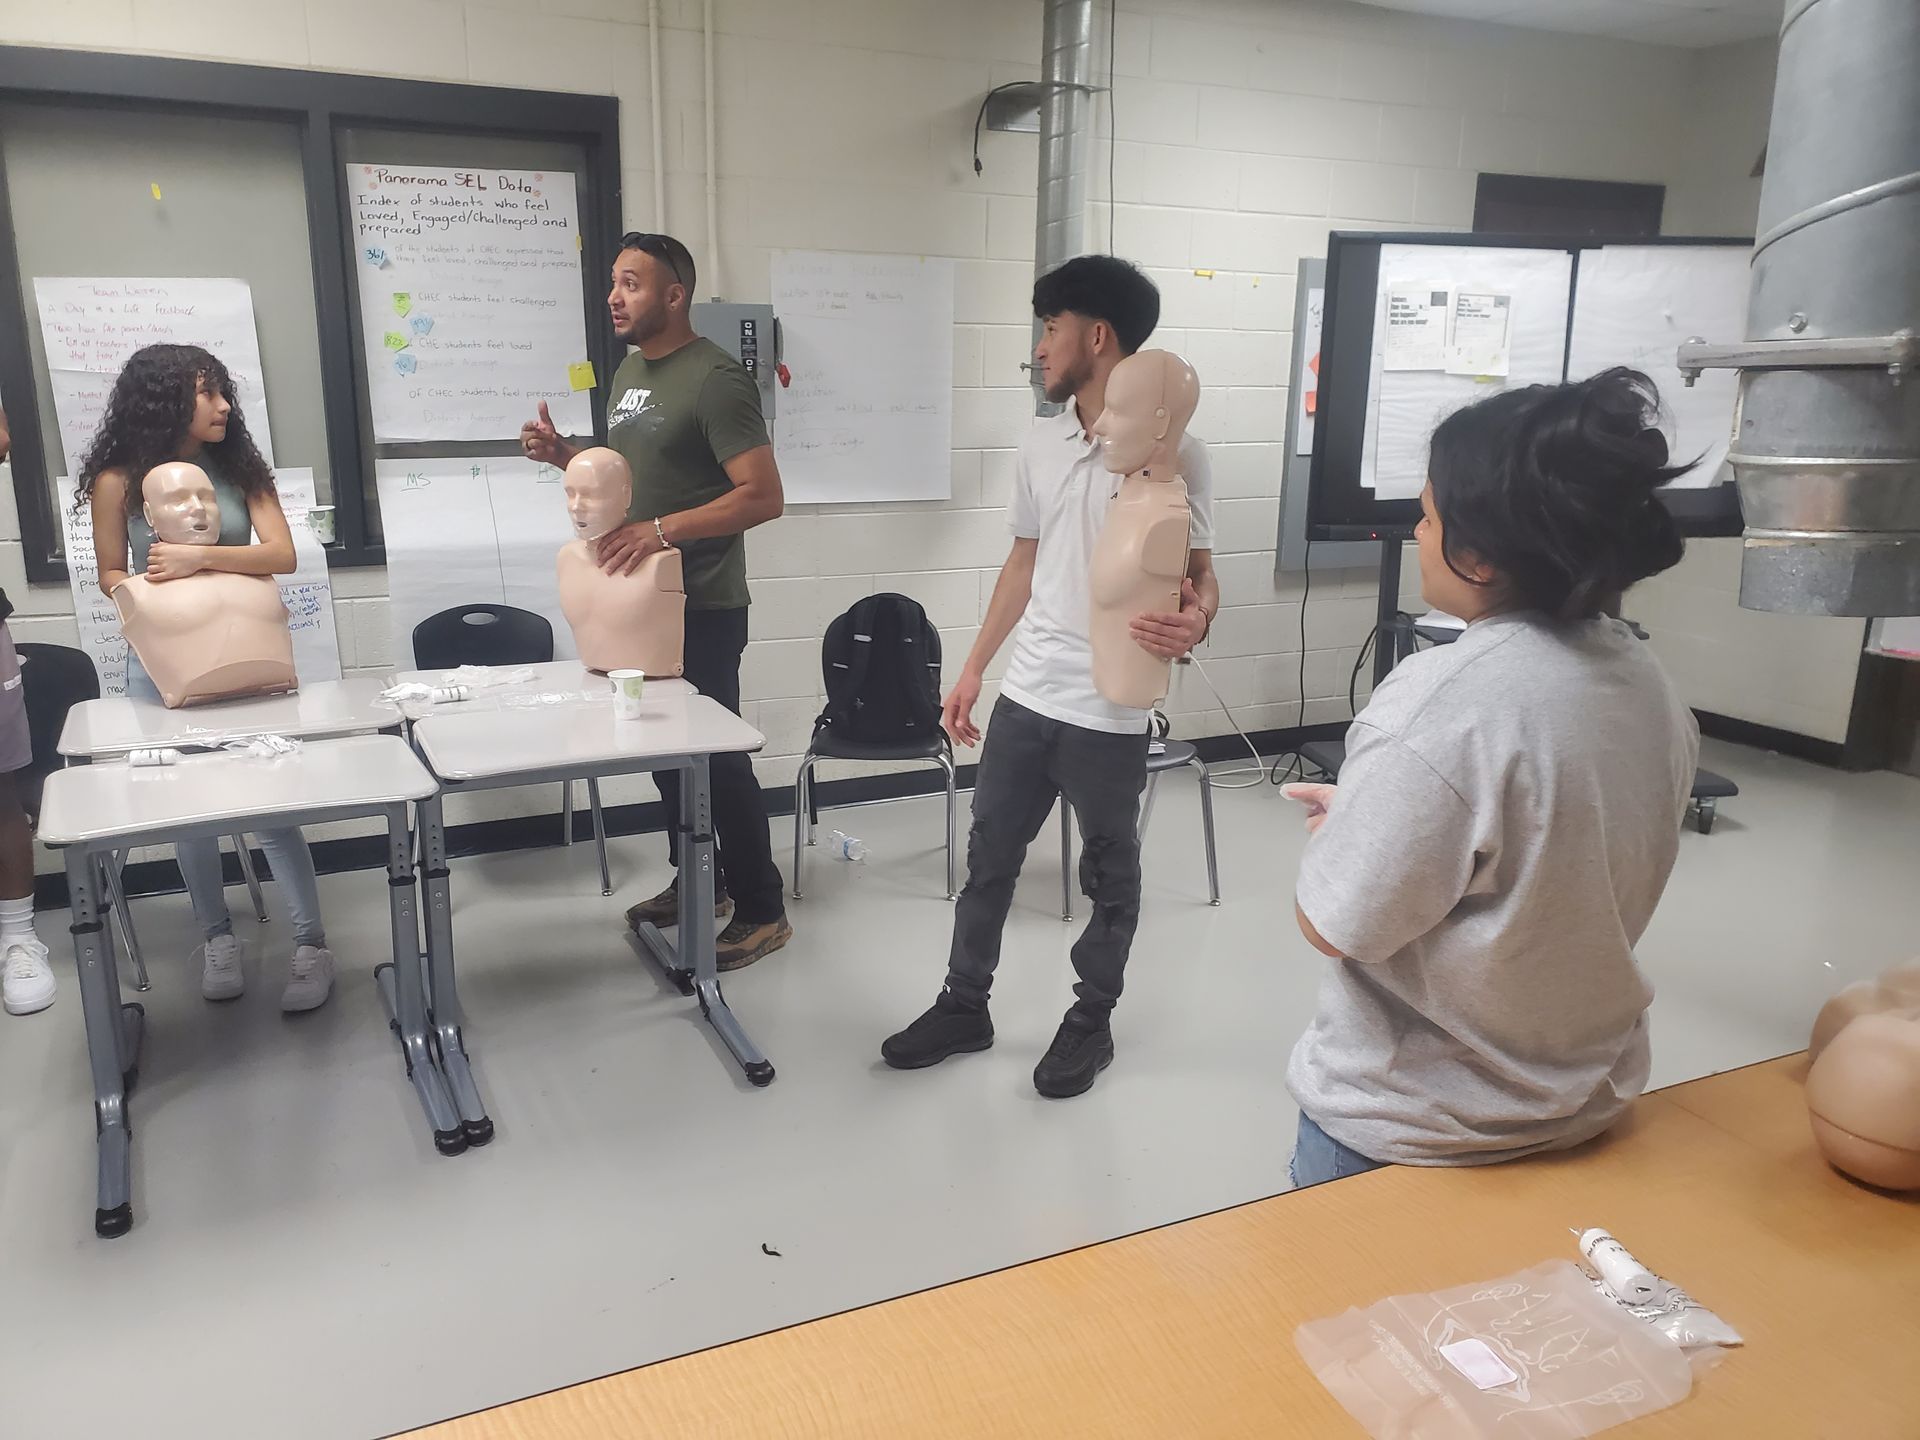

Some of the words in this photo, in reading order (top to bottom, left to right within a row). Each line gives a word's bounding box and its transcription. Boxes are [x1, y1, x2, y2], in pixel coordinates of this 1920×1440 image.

[374, 168, 447, 187] Panorama
[454, 172, 487, 191] SEL
[498, 175, 532, 193] Data
[357, 194, 400, 206] Index
[410, 192, 422, 206] of
[429, 195, 483, 207] students
[494, 197, 519, 209] who
[525, 199, 549, 211] feel
[360, 210, 404, 225] Loved,
[542, 217, 568, 228] and
[359, 223, 421, 239] prepared
[744, 321, 753, 336] ON
[616, 388, 652, 411] JUST
[407, 472, 431, 487] MS
[92, 610, 117, 624] How
